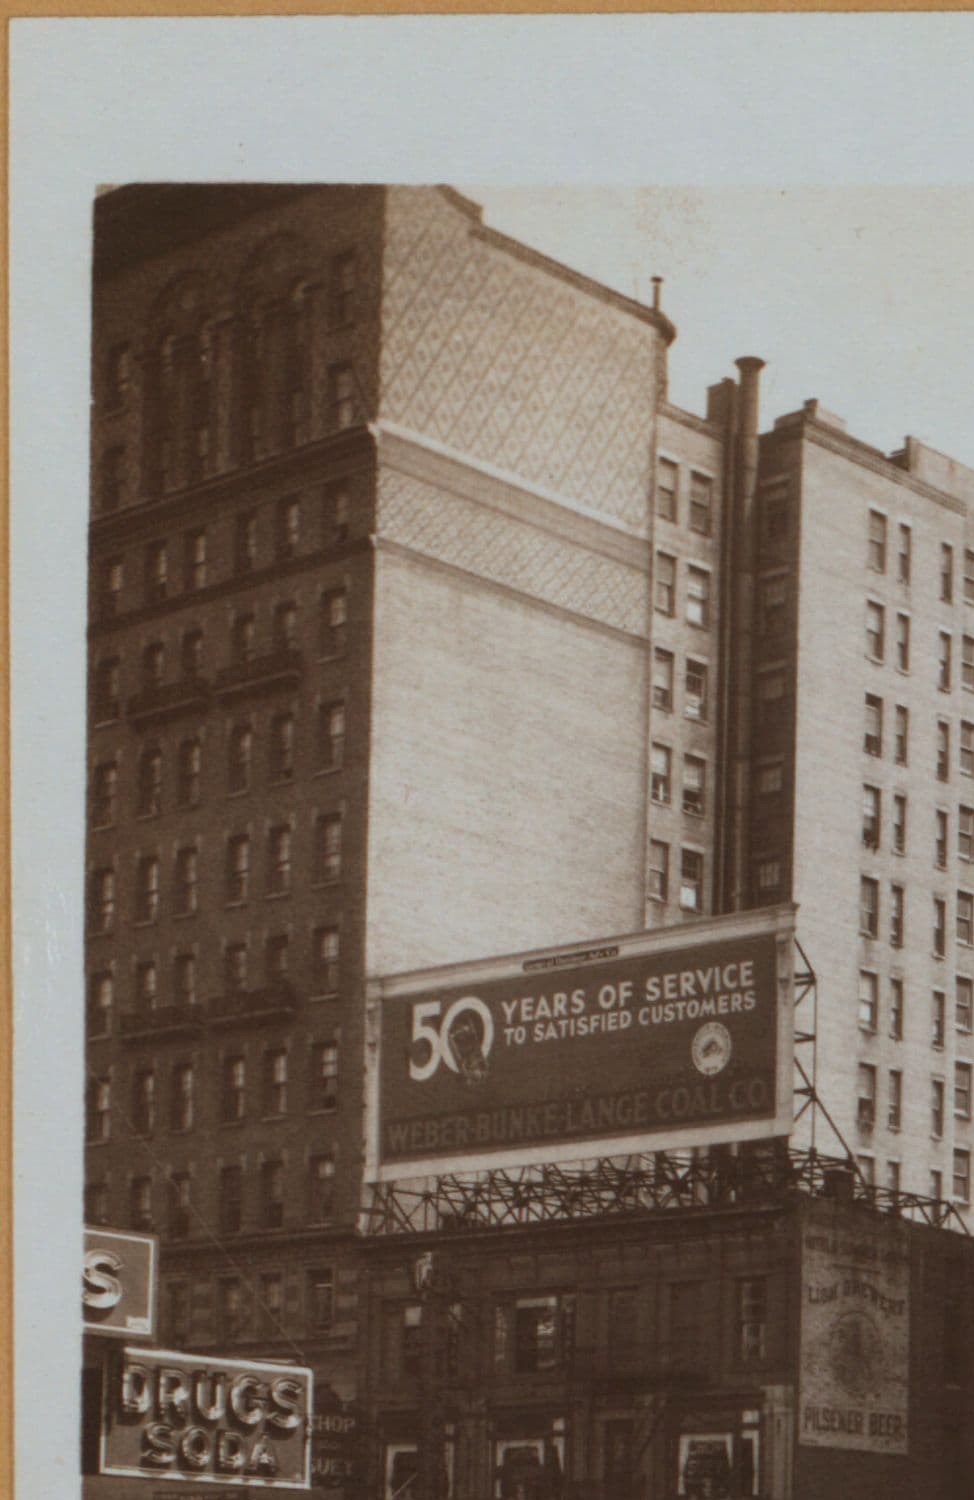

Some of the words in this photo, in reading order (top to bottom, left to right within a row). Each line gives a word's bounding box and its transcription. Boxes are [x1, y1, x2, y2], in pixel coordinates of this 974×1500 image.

[501, 988, 585, 1024] YEARS
[598, 980, 633, 1010] OF
[646, 960, 755, 1002] SERVICE
[503, 1027, 527, 1046] TO
[534, 1010, 632, 1043] SATISFIED
[638, 990, 756, 1026] CUSTOMERS
[410, 996, 493, 1082] 50
[655, 1082, 723, 1119] COAL
[121, 1364, 303, 1430] DRUGS
[805, 1406, 863, 1435] PILSENER
[870, 1412, 902, 1437] BEER
[142, 1422, 277, 1470] SODA
